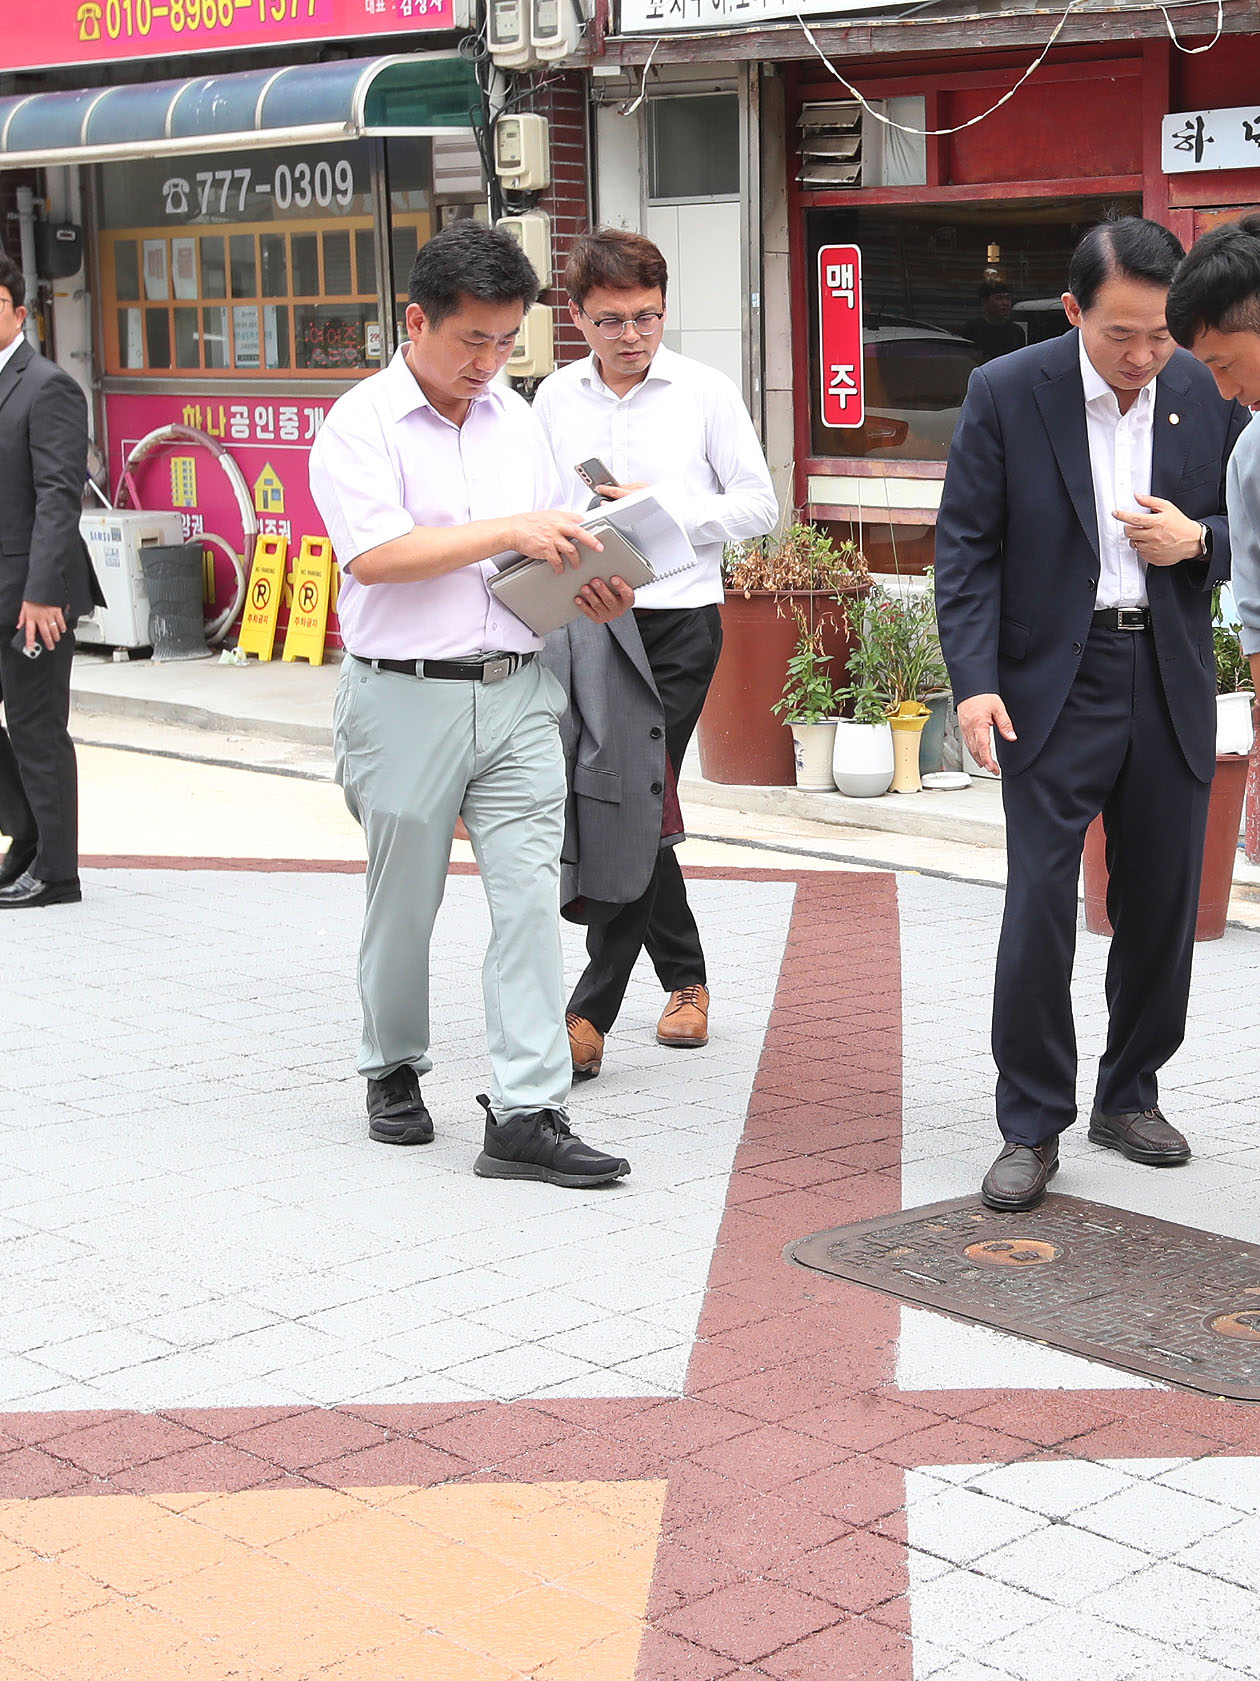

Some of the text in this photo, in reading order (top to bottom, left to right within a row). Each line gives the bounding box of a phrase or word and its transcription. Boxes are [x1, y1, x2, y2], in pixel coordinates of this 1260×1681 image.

[196, 160, 353, 214] 777-0309
[247, 614, 269, 625] 주차금지
[294, 616, 318, 628] 주차금지
